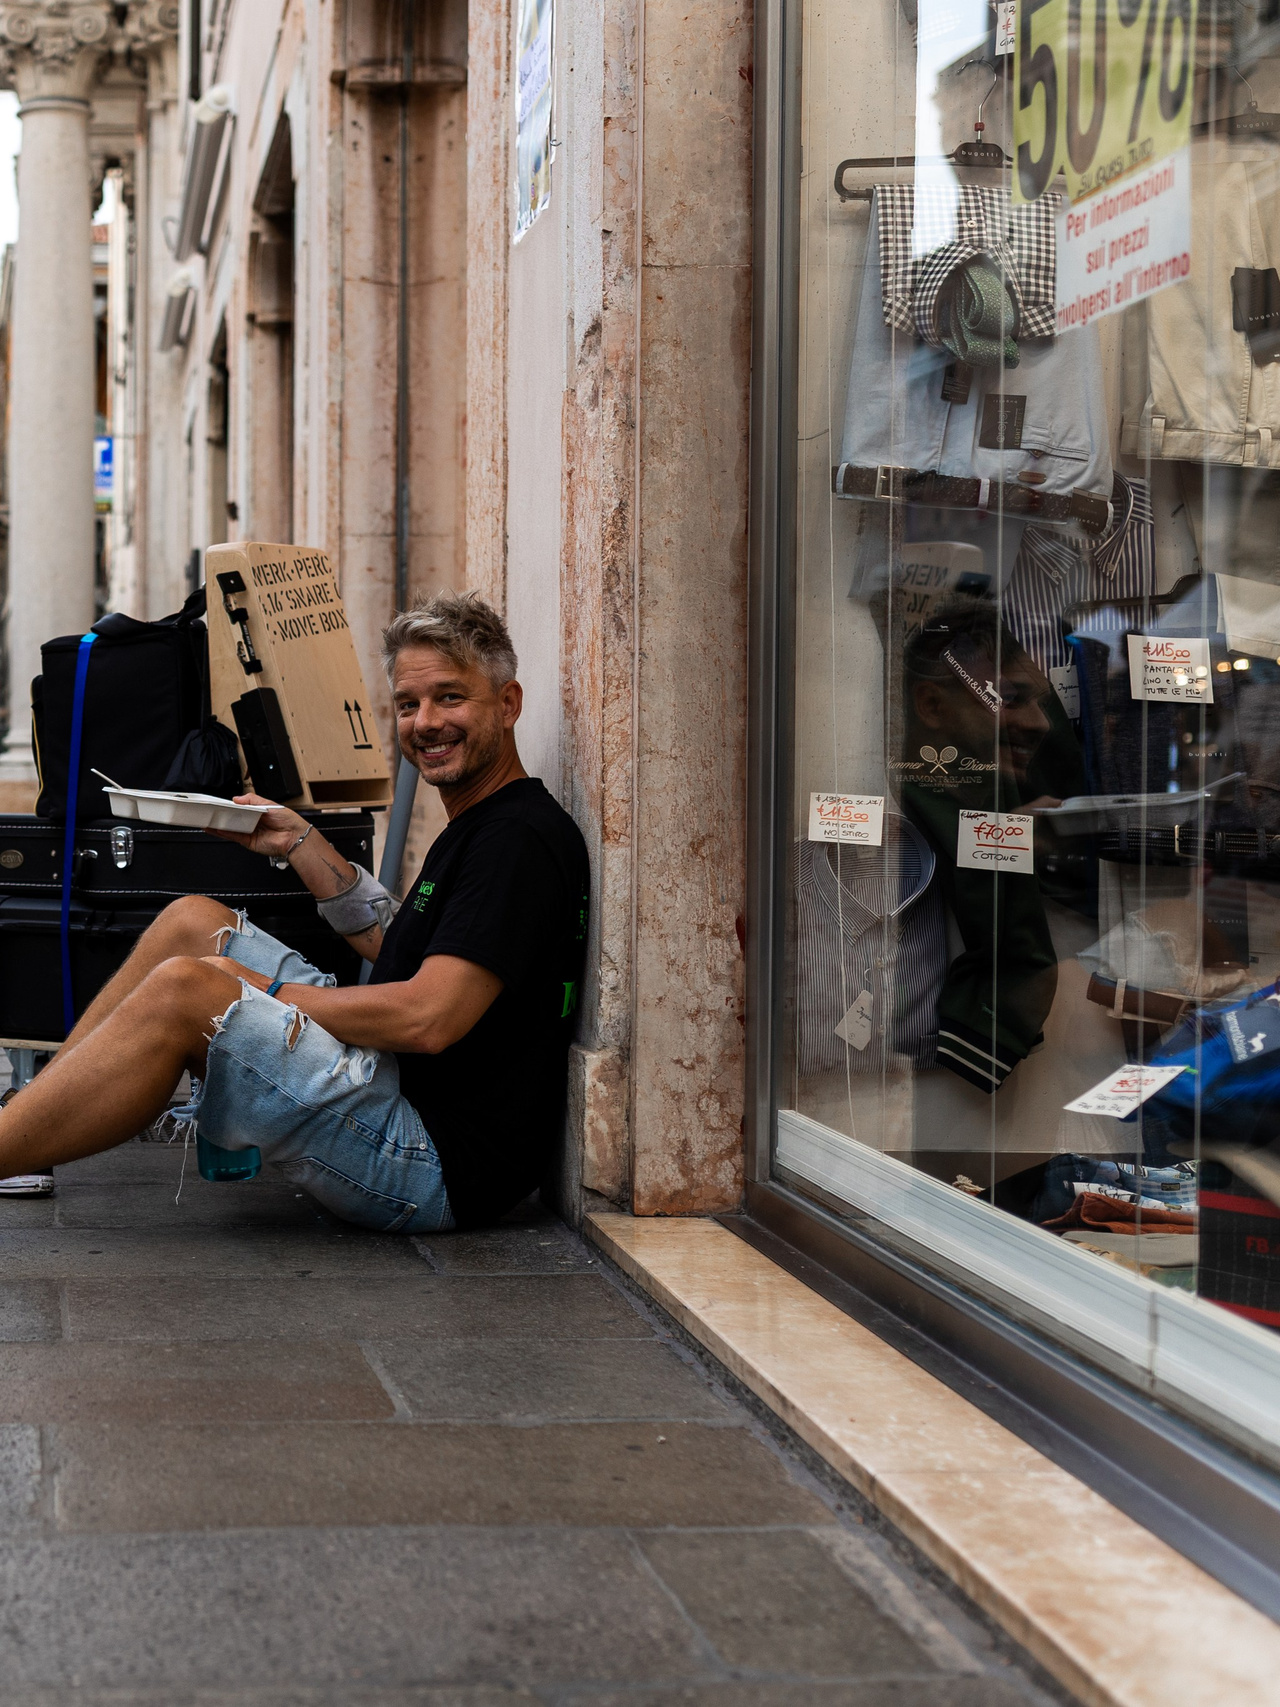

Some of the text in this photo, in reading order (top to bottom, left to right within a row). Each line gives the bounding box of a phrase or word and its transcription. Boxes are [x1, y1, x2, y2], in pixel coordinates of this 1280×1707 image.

[1018, 0, 1191, 200] 50%
[961, 150, 999, 158] bugatti
[1066, 158, 1175, 242] Per informazioni
[1086, 216, 1150, 274] sui prezzi
[1057, 280, 1112, 331] rivolgersi
[319, 609, 349, 633] BOX
[1143, 641, 1191, 660] €115,00
[1144, 664, 1193, 674] PANTALONI
[943, 649, 1000, 713] harmont&blaine
[1143, 677, 1161, 685] LINO
[817, 804, 869, 821] €115,00
[842, 830, 870, 838] STIRO
[973, 821, 1024, 843] €70,00
[972, 850, 1019, 862] COTONE
